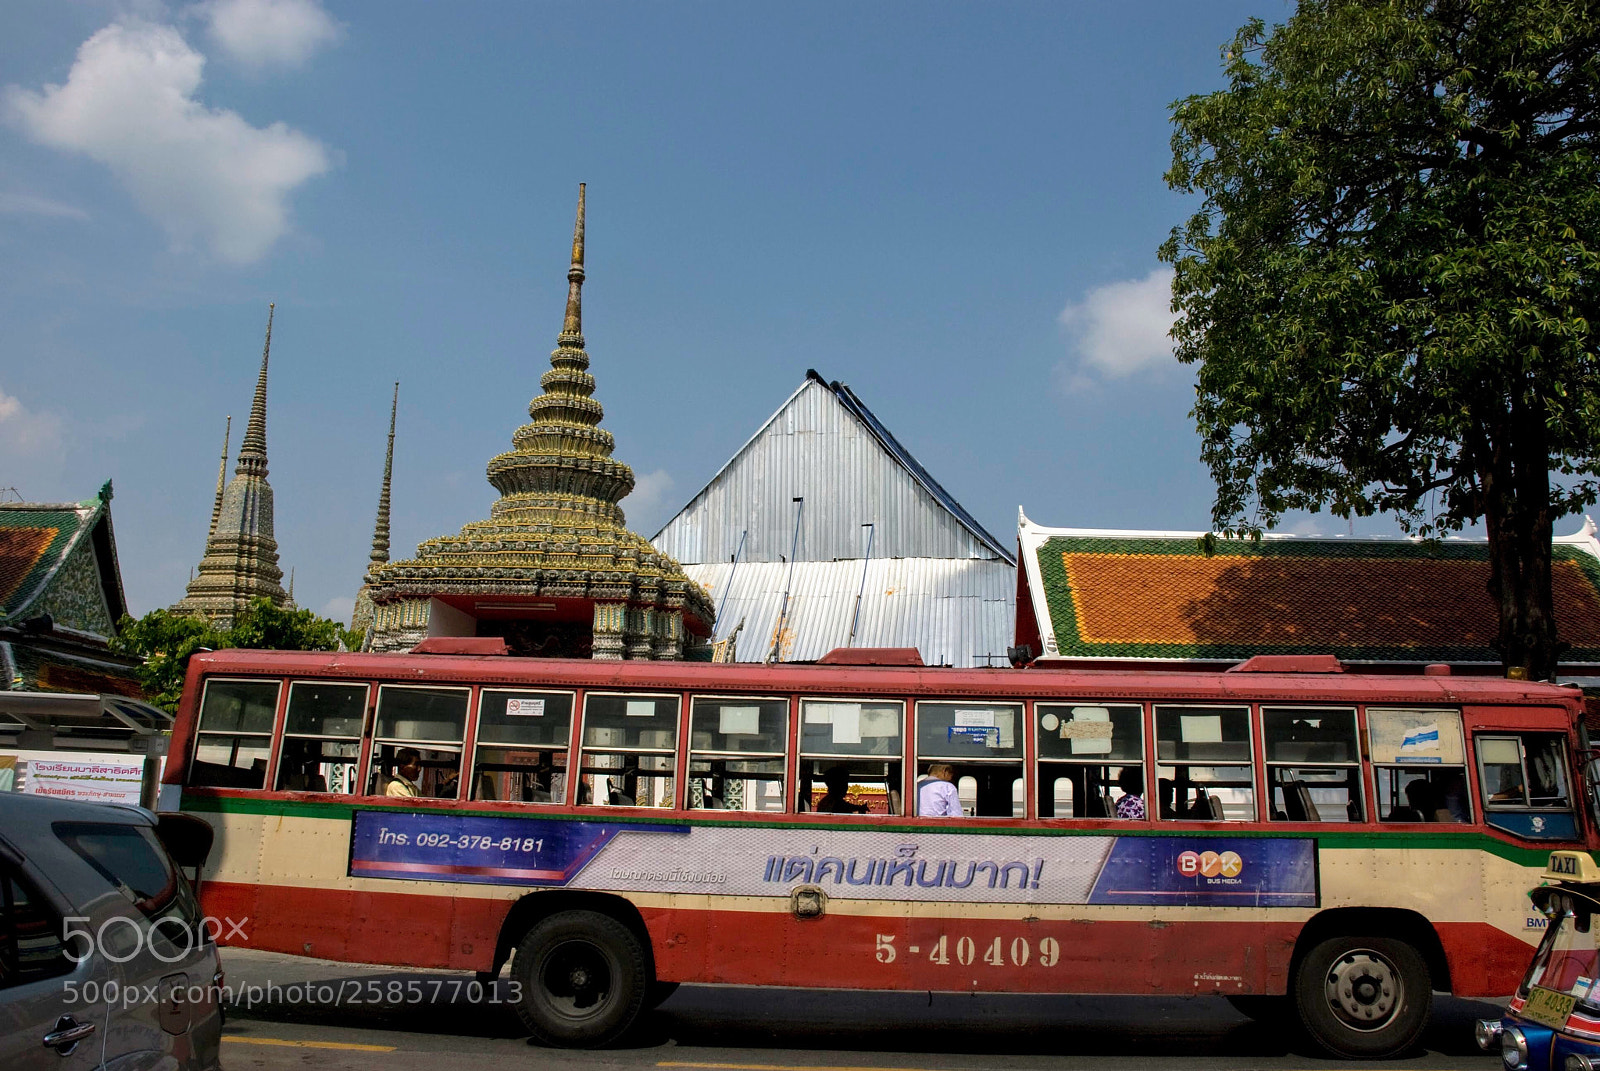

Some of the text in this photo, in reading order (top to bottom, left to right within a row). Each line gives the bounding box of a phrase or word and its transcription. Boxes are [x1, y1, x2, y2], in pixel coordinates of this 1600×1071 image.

[378, 827, 544, 853] โทร. 092-378-8181
[762, 843, 1045, 890] แต่คนเห็นมาก!
[1181, 855, 1238, 873] BVK
[1550, 855, 1577, 875] TAXI
